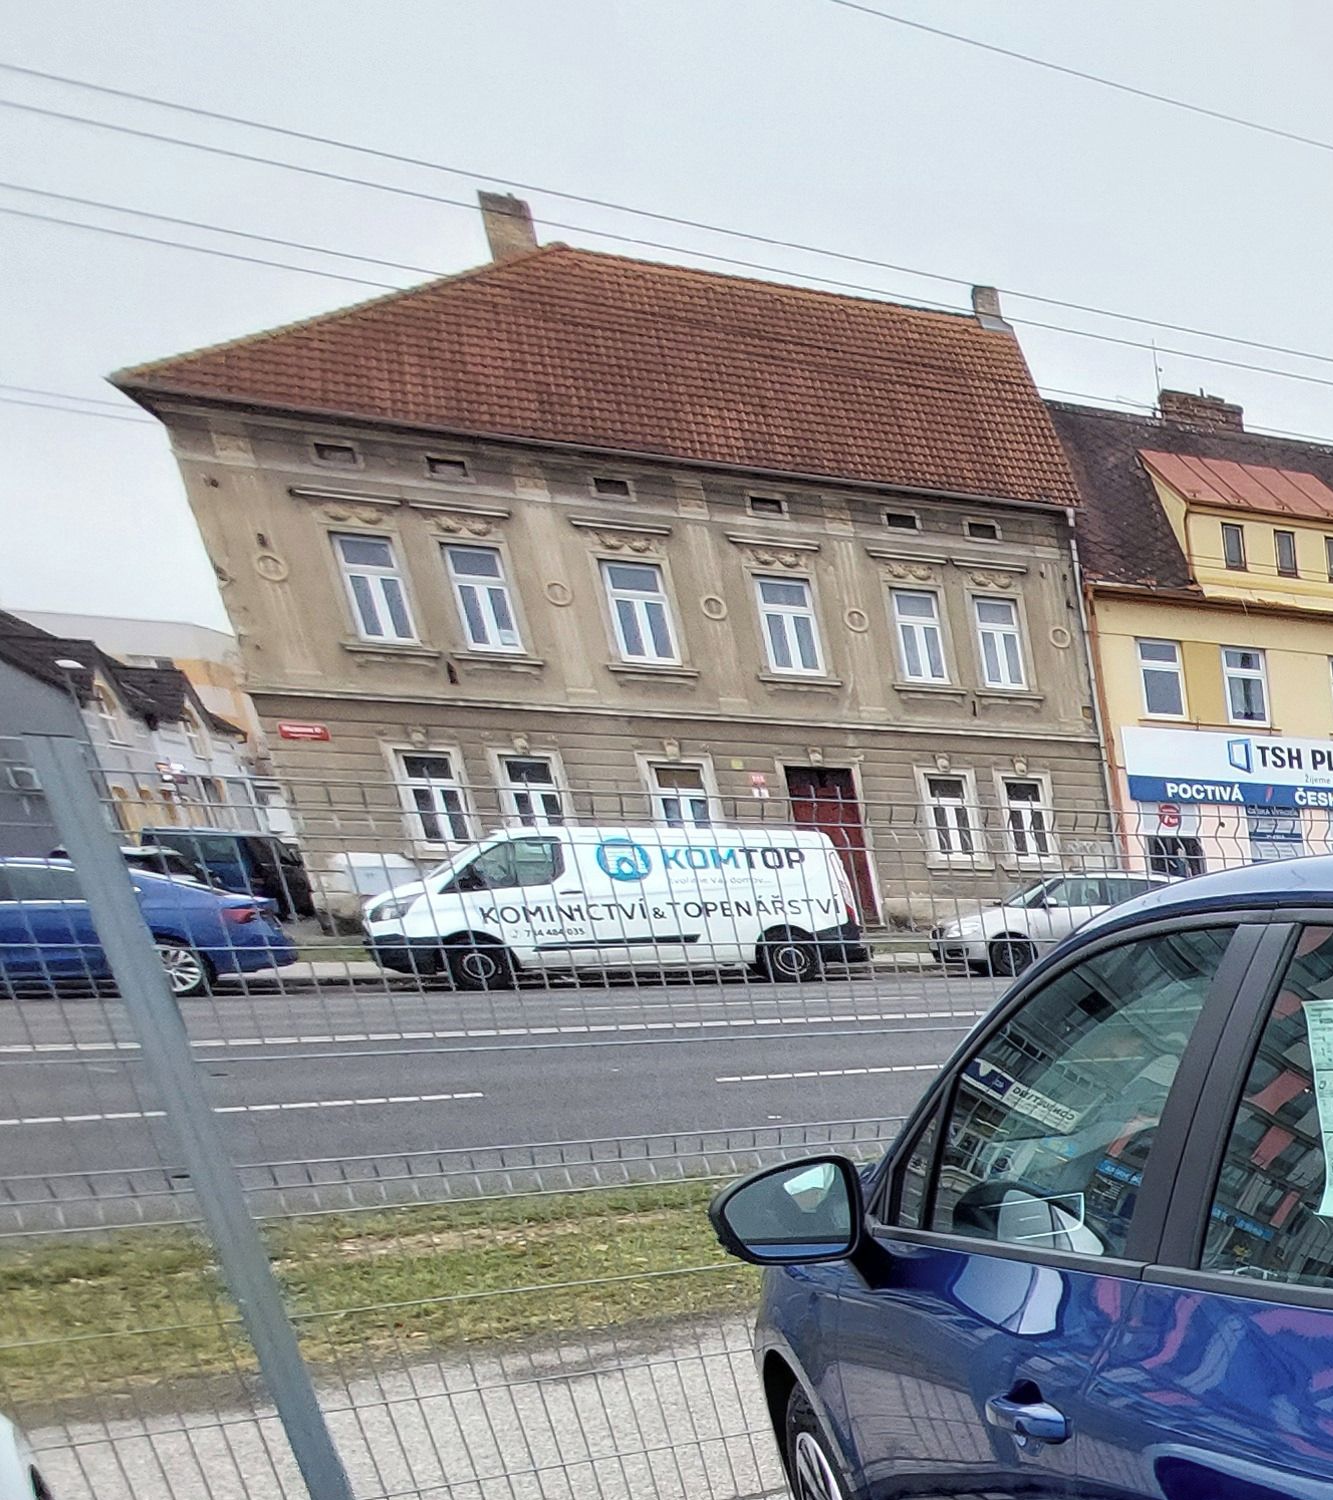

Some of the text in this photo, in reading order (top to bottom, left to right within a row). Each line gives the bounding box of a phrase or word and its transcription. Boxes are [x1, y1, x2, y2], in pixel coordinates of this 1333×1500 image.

[1256, 745, 1303, 770] TSH
[1165, 782, 1245, 802] POCTIVÁ
[661, 847, 805, 870] KOMTOP
[479, 894, 841, 924] KOMINICTVÍ & TOPENÁŘSTVÍ
